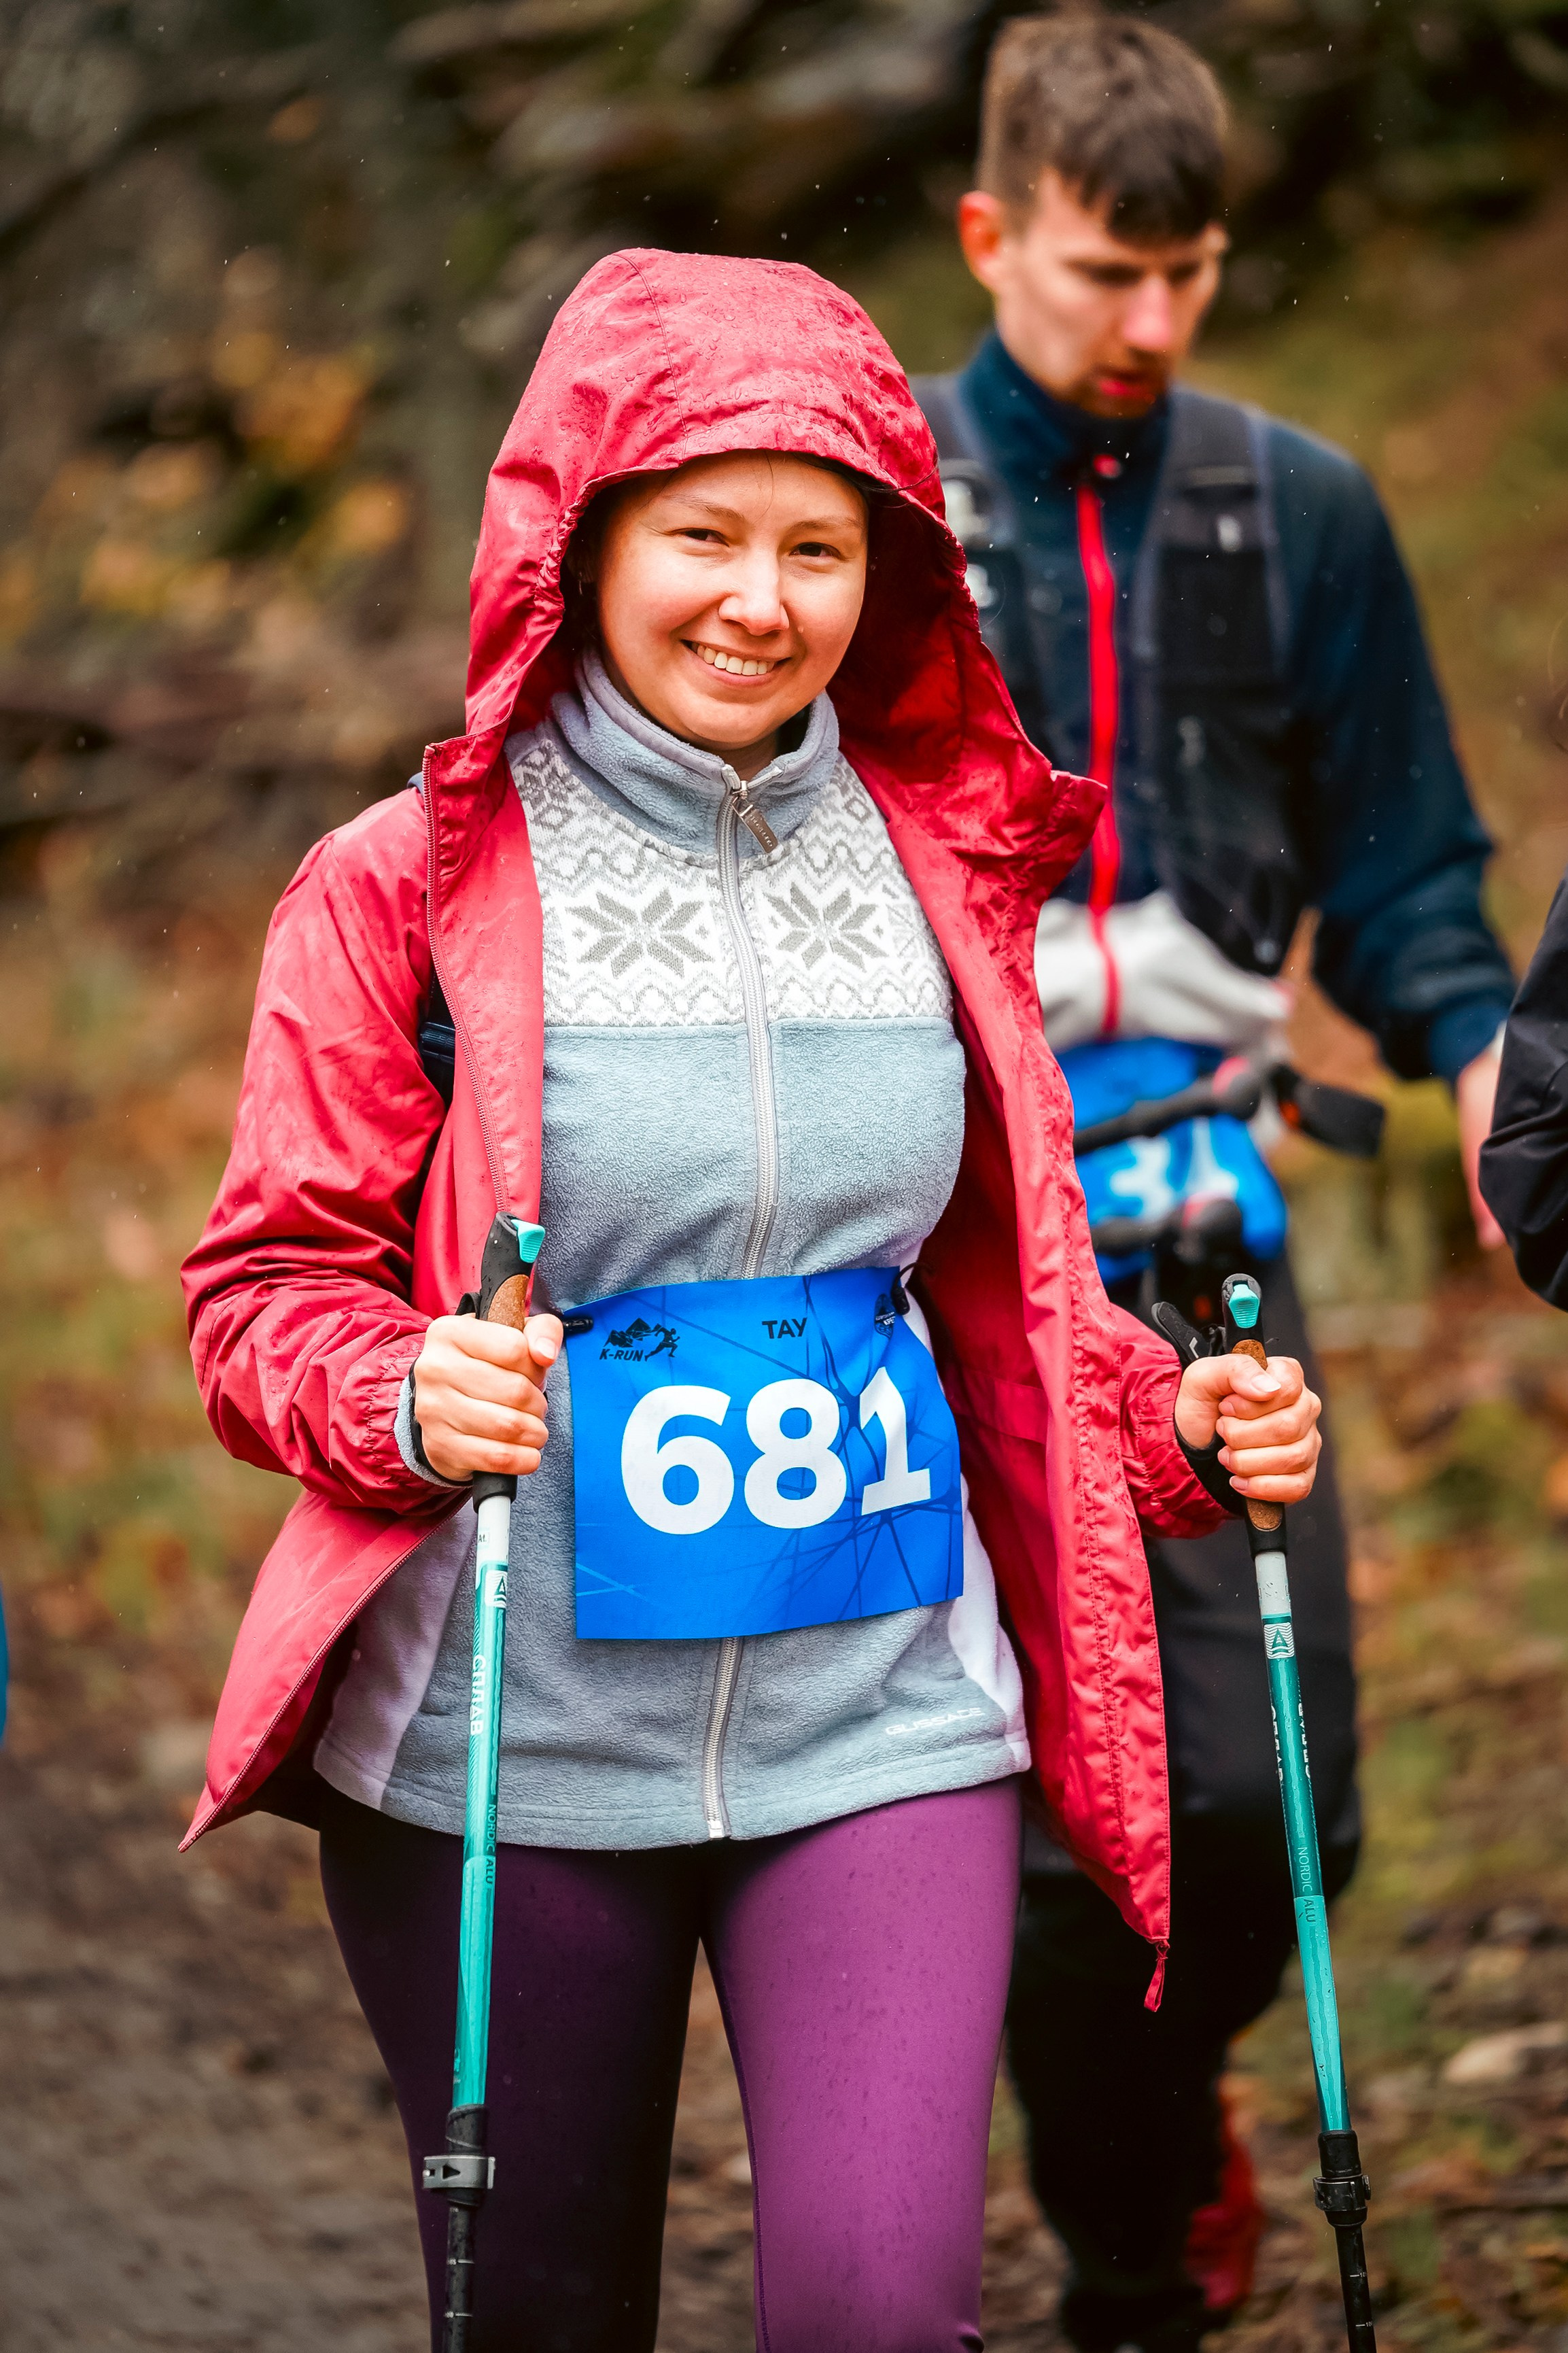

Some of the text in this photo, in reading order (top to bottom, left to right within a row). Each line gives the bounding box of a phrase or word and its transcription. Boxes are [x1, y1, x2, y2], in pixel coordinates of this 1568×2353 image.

[761, 1317, 807, 1339] TAY
[599, 1348, 644, 1362] K-RUN
[621, 1367, 931, 1535] 681
[886, 1707, 985, 1735] GLISSADE
[485, 1804, 496, 1885] NORDIC ALU
[1297, 1847, 1316, 1923] NORDIC ALU
